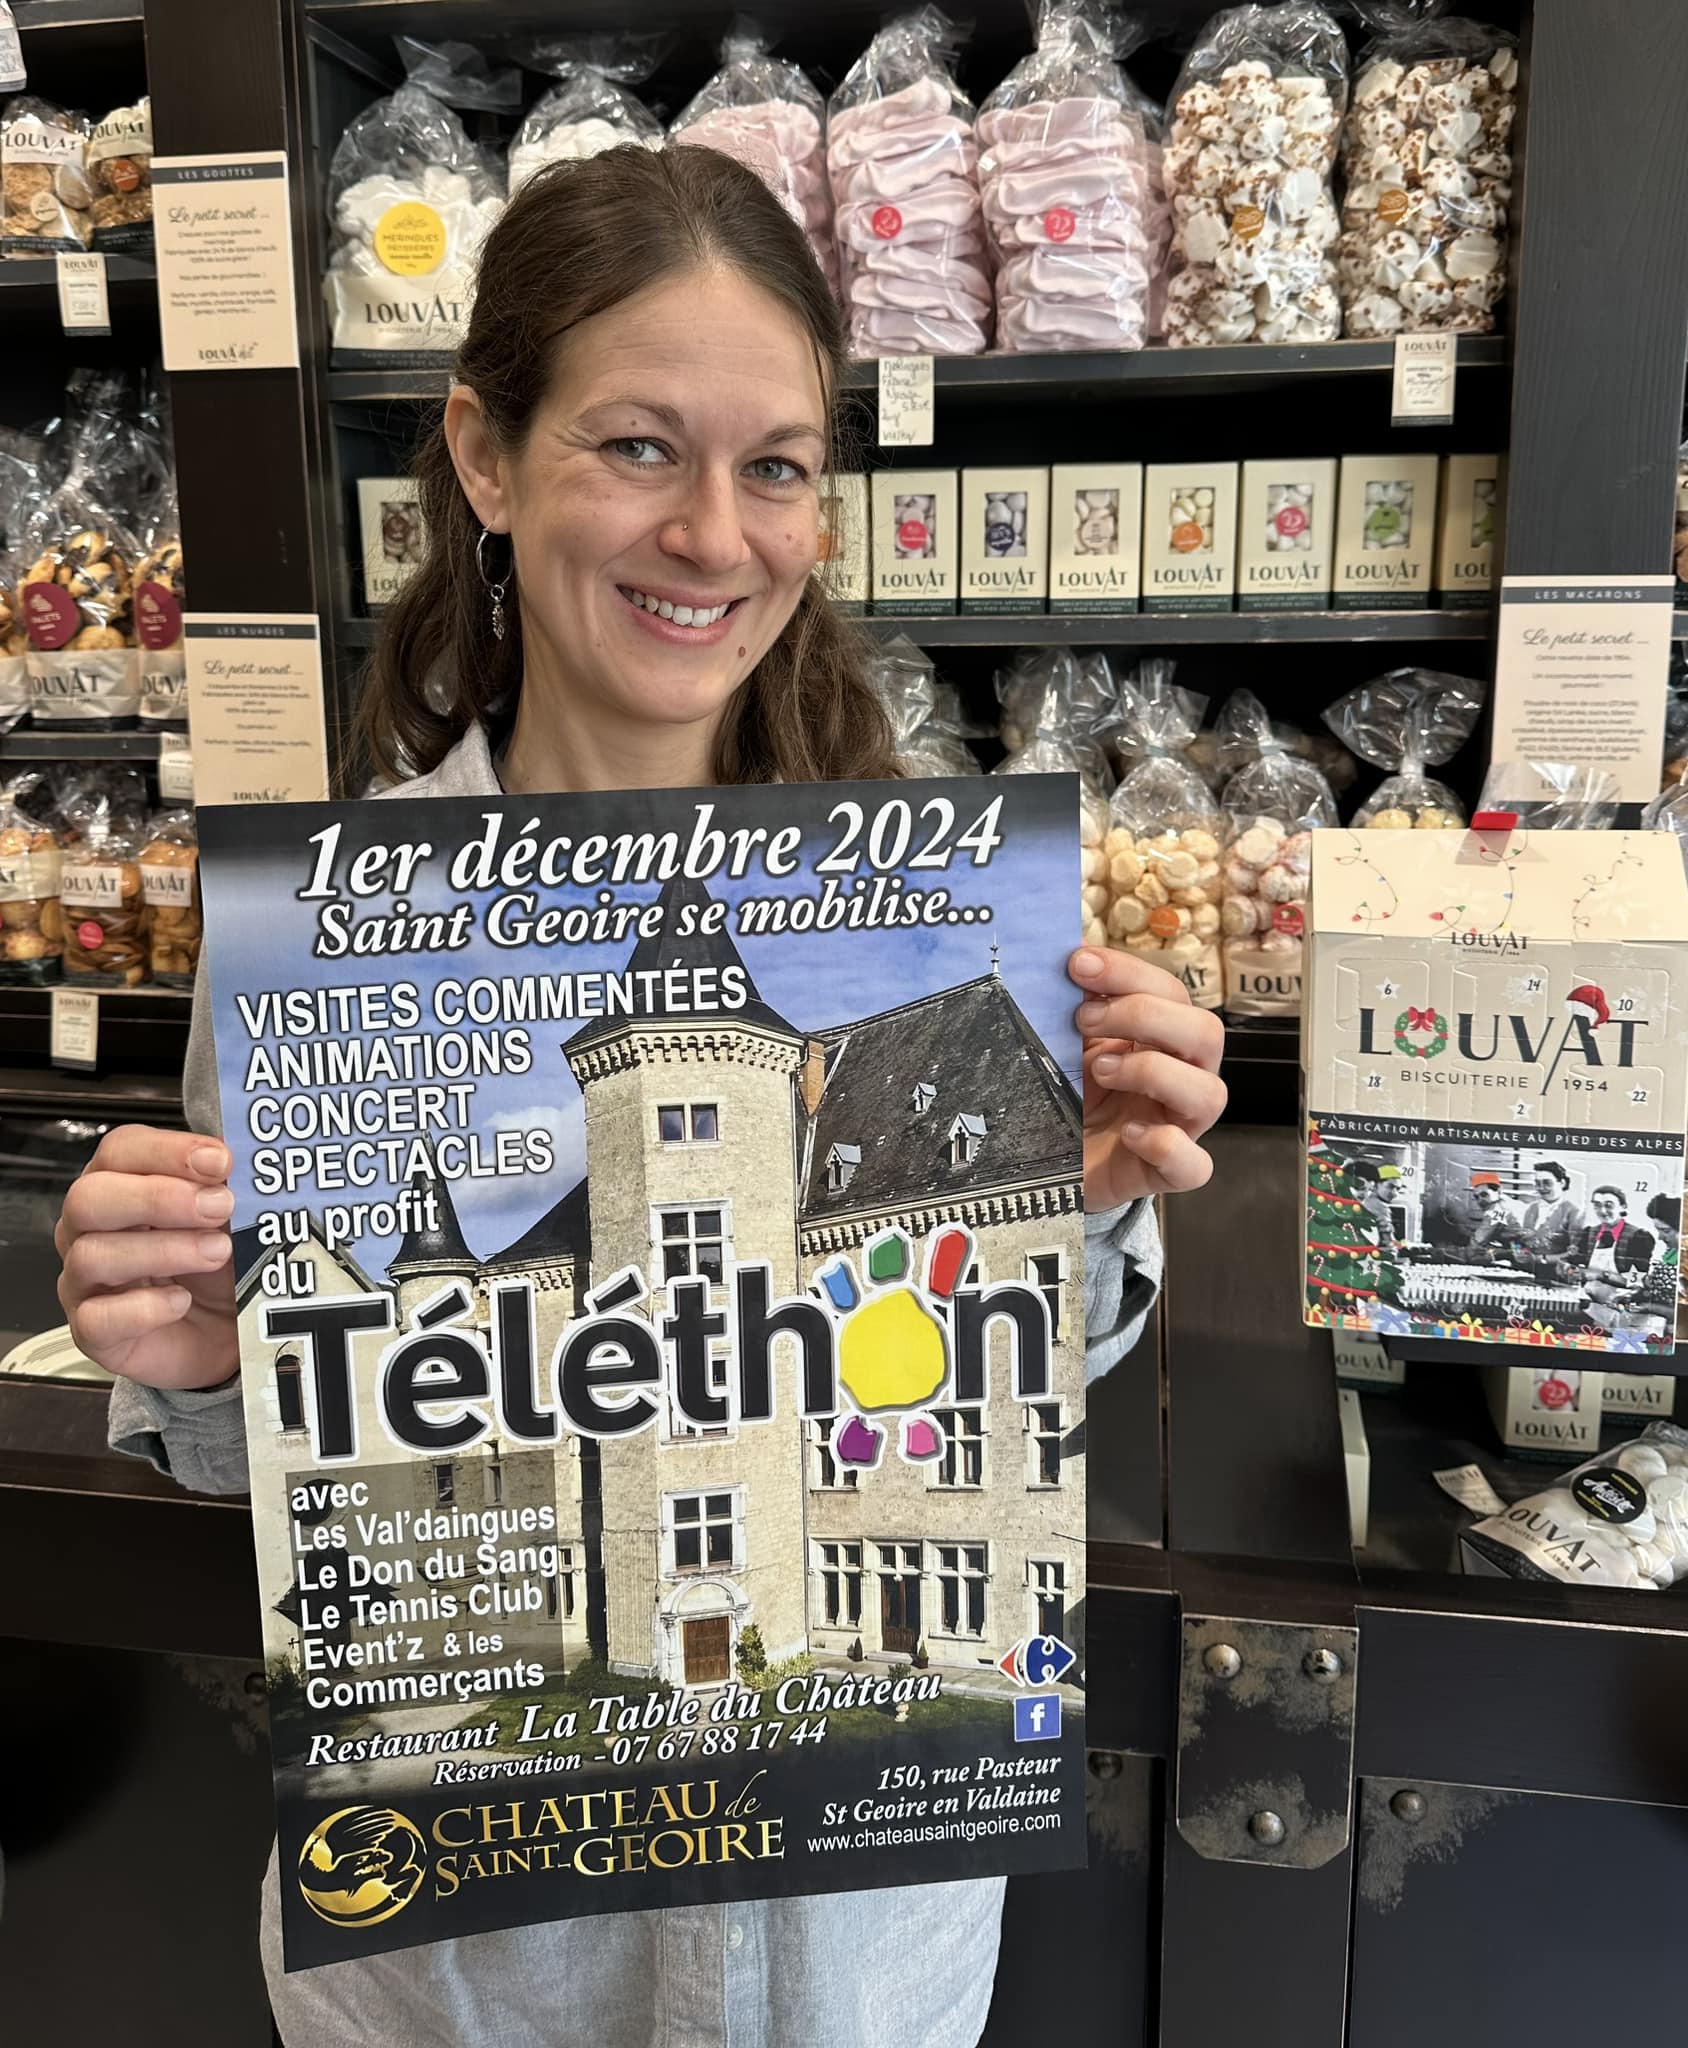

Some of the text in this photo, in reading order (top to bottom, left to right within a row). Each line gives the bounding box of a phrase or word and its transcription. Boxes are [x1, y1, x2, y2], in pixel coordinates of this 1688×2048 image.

[95, 122, 145, 142] OUVAT
[178, 168, 255, 180] LES GOUTTES
[168, 206, 190, 223] Le
[189, 209, 221, 228] petit
[223, 206, 257, 220] secret
[365, 292, 464, 336] LOUVAT
[882, 568, 947, 594] LOUVAT
[969, 566, 1037, 592] LOUVAT
[1059, 566, 1128, 593] LOUVAT
[1153, 563, 1225, 590] LOUVAT
[1250, 560, 1321, 588] LOUVAT
[1345, 560, 1421, 587] LOUVAT
[1454, 563, 1490, 579] LOU
[1534, 590, 1642, 601] LES MACARONS
[241, 626, 286, 637] NUAGES
[1522, 628, 1549, 646] Le
[1549, 631, 1588, 650] petit
[1591, 631, 1634, 646] secret
[32, 668, 100, 698] OUVAT
[204, 659, 226, 675] Le
[226, 663, 255, 680] petit
[257, 663, 292, 675] secret
[299, 793, 1004, 899] 1er décembre 2024
[64, 874, 117, 897] OUVAT
[316, 876, 991, 957] Saint Geoire se mobilise...
[1450, 930, 1530, 955] LOUVAT
[1239, 973, 1303, 995] LOU
[1383, 983, 1393, 997] 6
[1526, 977, 1542, 992] 14
[236, 957, 749, 1040] VISITES COMMENTÉES
[1617, 997, 1634, 1012] 10
[244, 1028, 532, 1092] ANIMATIONS
[1366, 1074, 1382, 1089] 18
[1400, 1069, 1609, 1093] BISCUITERIE 1954
[1516, 1103, 1525, 1116] 2
[1631, 1090, 1647, 1103] 22
[249, 1083, 477, 1143] CONCERT
[1319, 1117, 1683, 1151] FABRICATION ARTISANALE AU PIED DES ALPES
[252, 1129, 553, 1195] SPECTACLES
[1400, 1165, 1415, 1178] 20
[1633, 1180, 1649, 1193] 12
[257, 1189, 440, 1251] au profit
[261, 1252, 316, 1297] du
[264, 1248, 1053, 1462] Téléthon
[1602, 1386, 1664, 1410] OUVAT
[1514, 1420, 1590, 1447] LOUVAT
[290, 1480, 369, 1512] avec
[293, 1504, 556, 1552] Les Val'daingues
[1508, 1508, 1602, 1573] OUVAT
[297, 1543, 559, 1592] Le Don du Sang
[300, 1578, 543, 1632] Le Tennis Club
[303, 1630, 504, 1671] Event'z & les
[306, 1657, 546, 1710] Commerçants
[304, 1672, 943, 1768] Restaurant La Table du Château
[432, 1750, 583, 1786] Réservation
[656, 1728, 697, 1761] 67
[701, 1726, 740, 1756] 88
[745, 1720, 786, 1751] 17
[788, 1716, 830, 1746] 44
[876, 1755, 1063, 1791] 150, rue Pasteur
[431, 1768, 768, 1849] CHATEAU de
[821, 1783, 1062, 1827] St Geoire en Valdaine
[806, 1812, 1062, 1853] www.chateausaintgeoire.com
[433, 1815, 787, 1903] SAINT-GEOIRE
